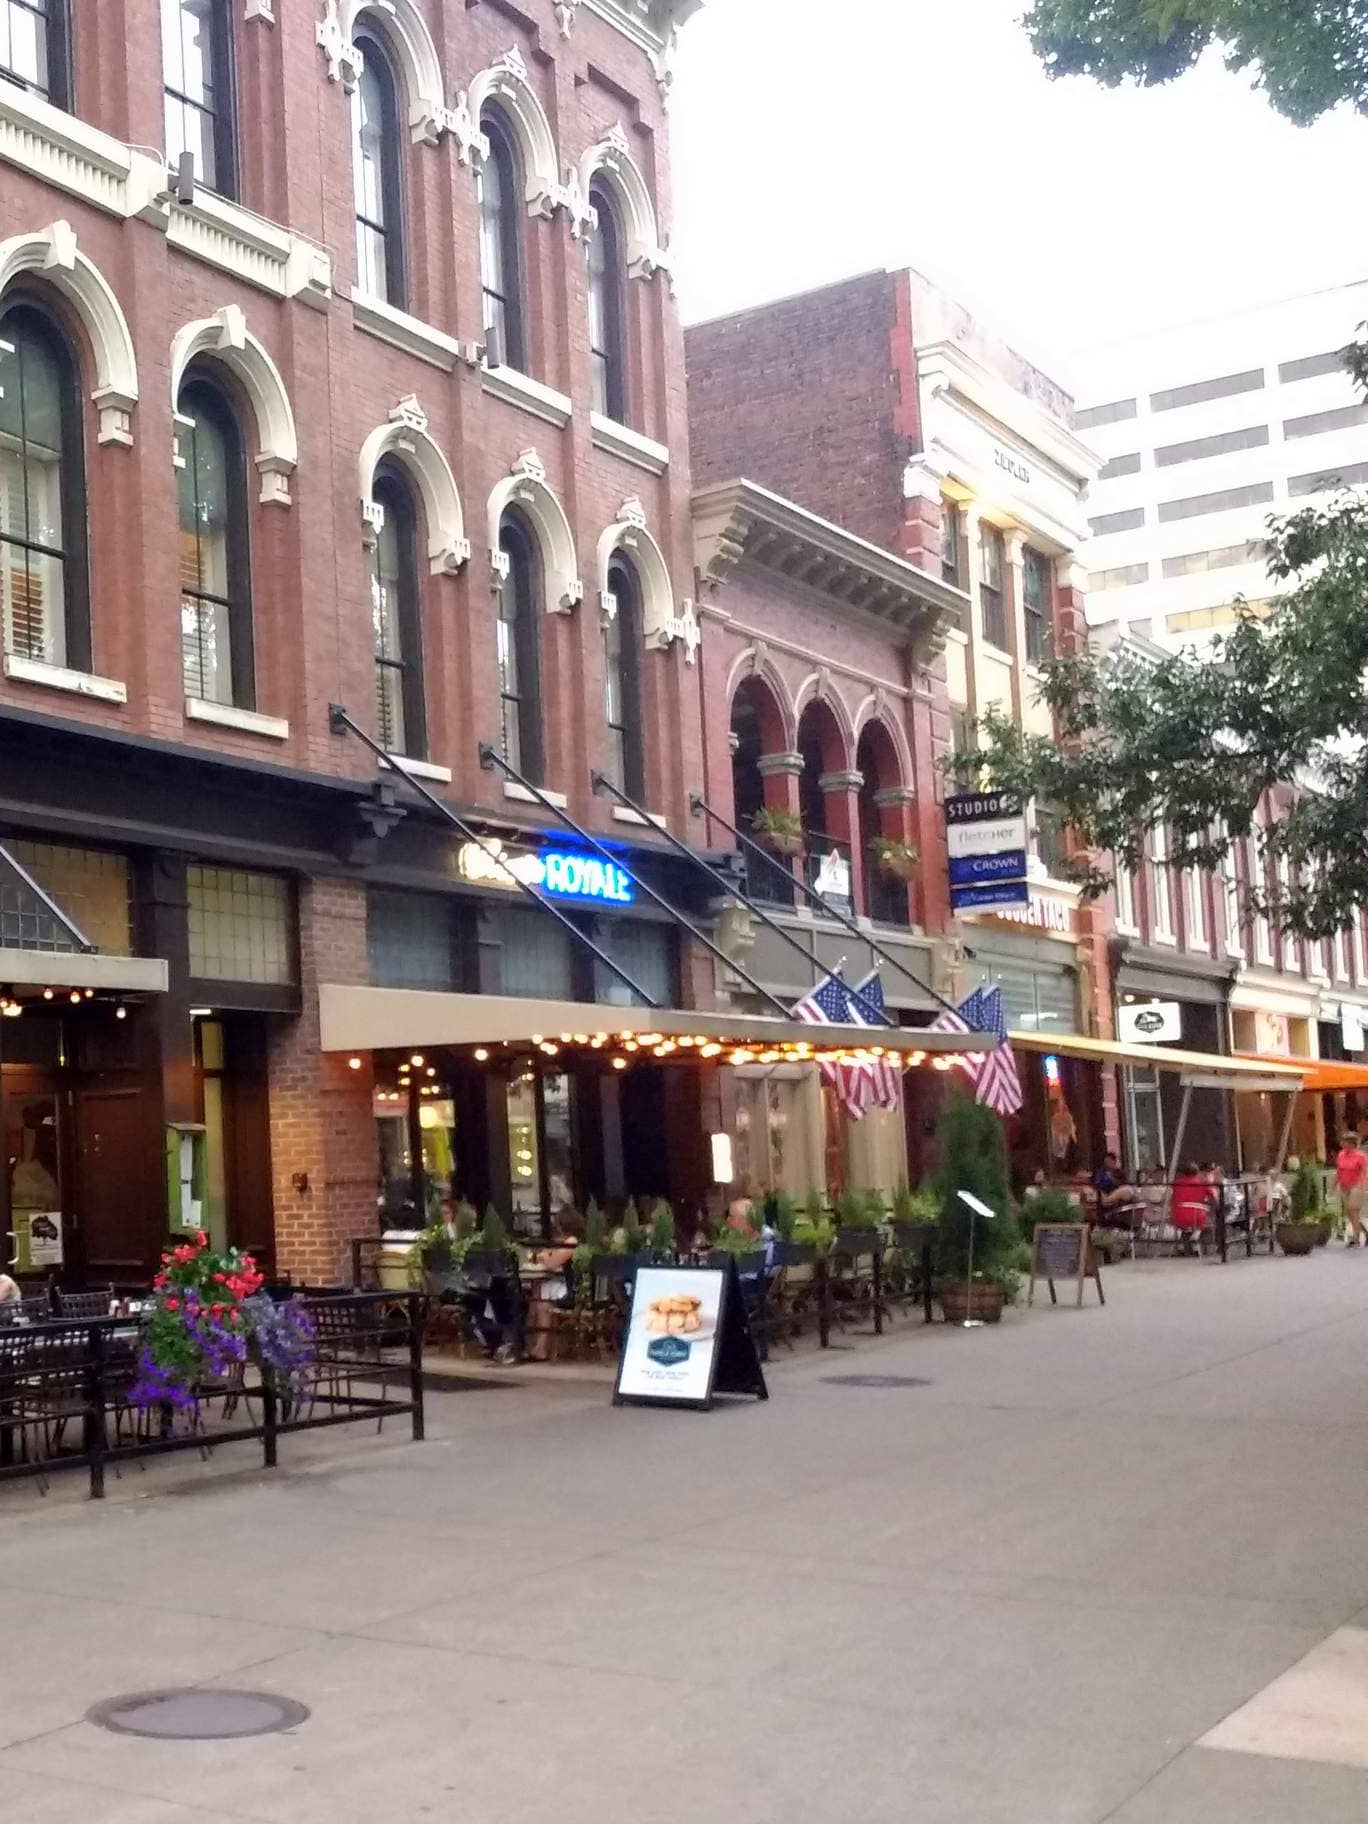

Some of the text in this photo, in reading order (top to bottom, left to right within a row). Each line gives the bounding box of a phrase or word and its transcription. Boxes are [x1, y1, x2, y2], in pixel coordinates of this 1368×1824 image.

[948, 799, 998, 818] STUDIO
[972, 857, 1019, 872] CROWN
[544, 853, 632, 902] ROYALE
